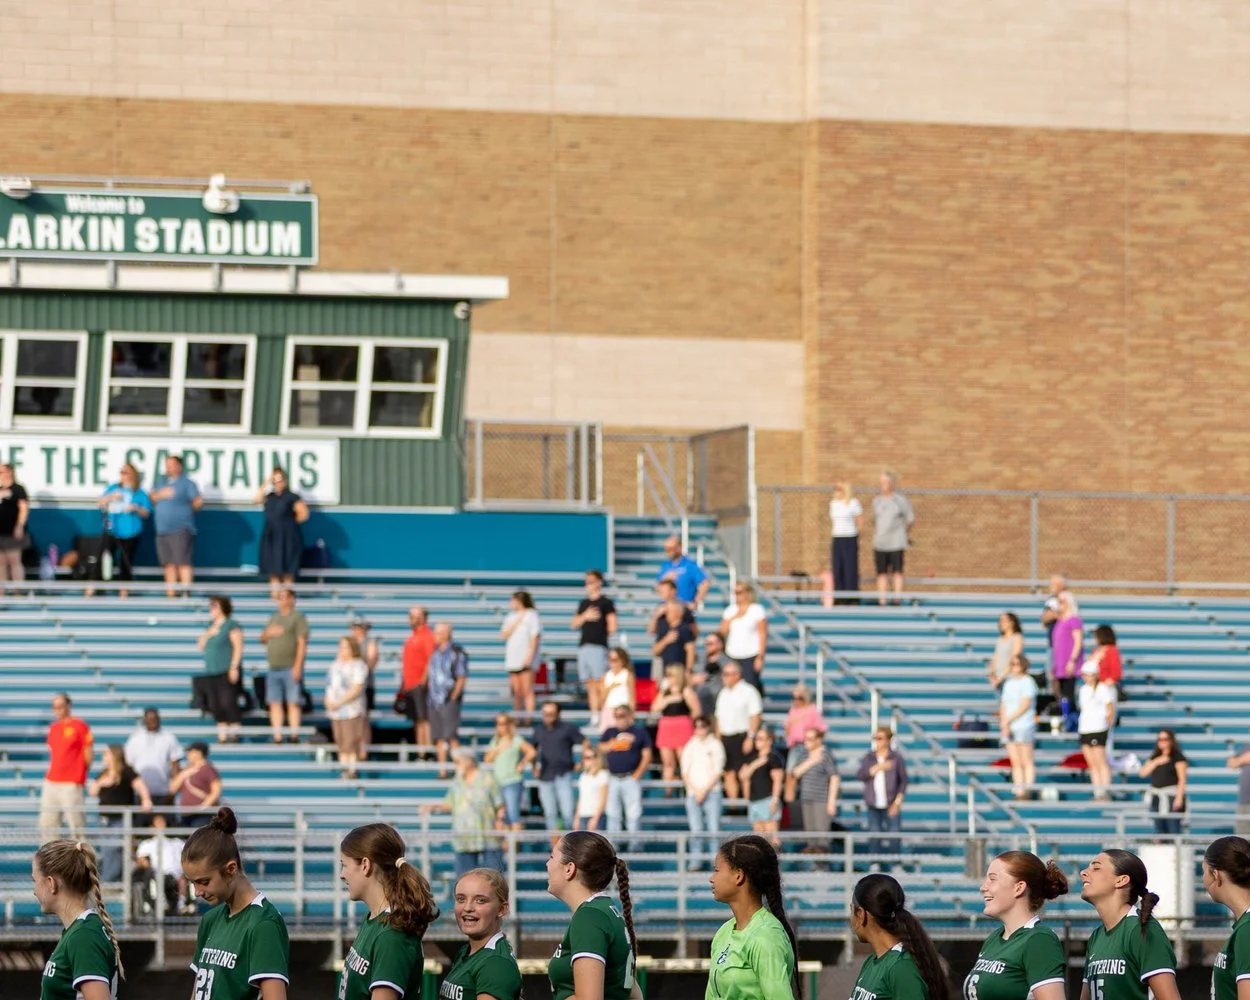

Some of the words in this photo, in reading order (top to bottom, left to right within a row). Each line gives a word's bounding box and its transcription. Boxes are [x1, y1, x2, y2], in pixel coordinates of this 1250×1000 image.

[64, 194, 126, 214] Welcome
[127, 197, 146, 215] to
[0, 214, 125, 251] ARKIN
[134, 217, 302, 257] STADIUM
[40, 446, 108, 487] THE
